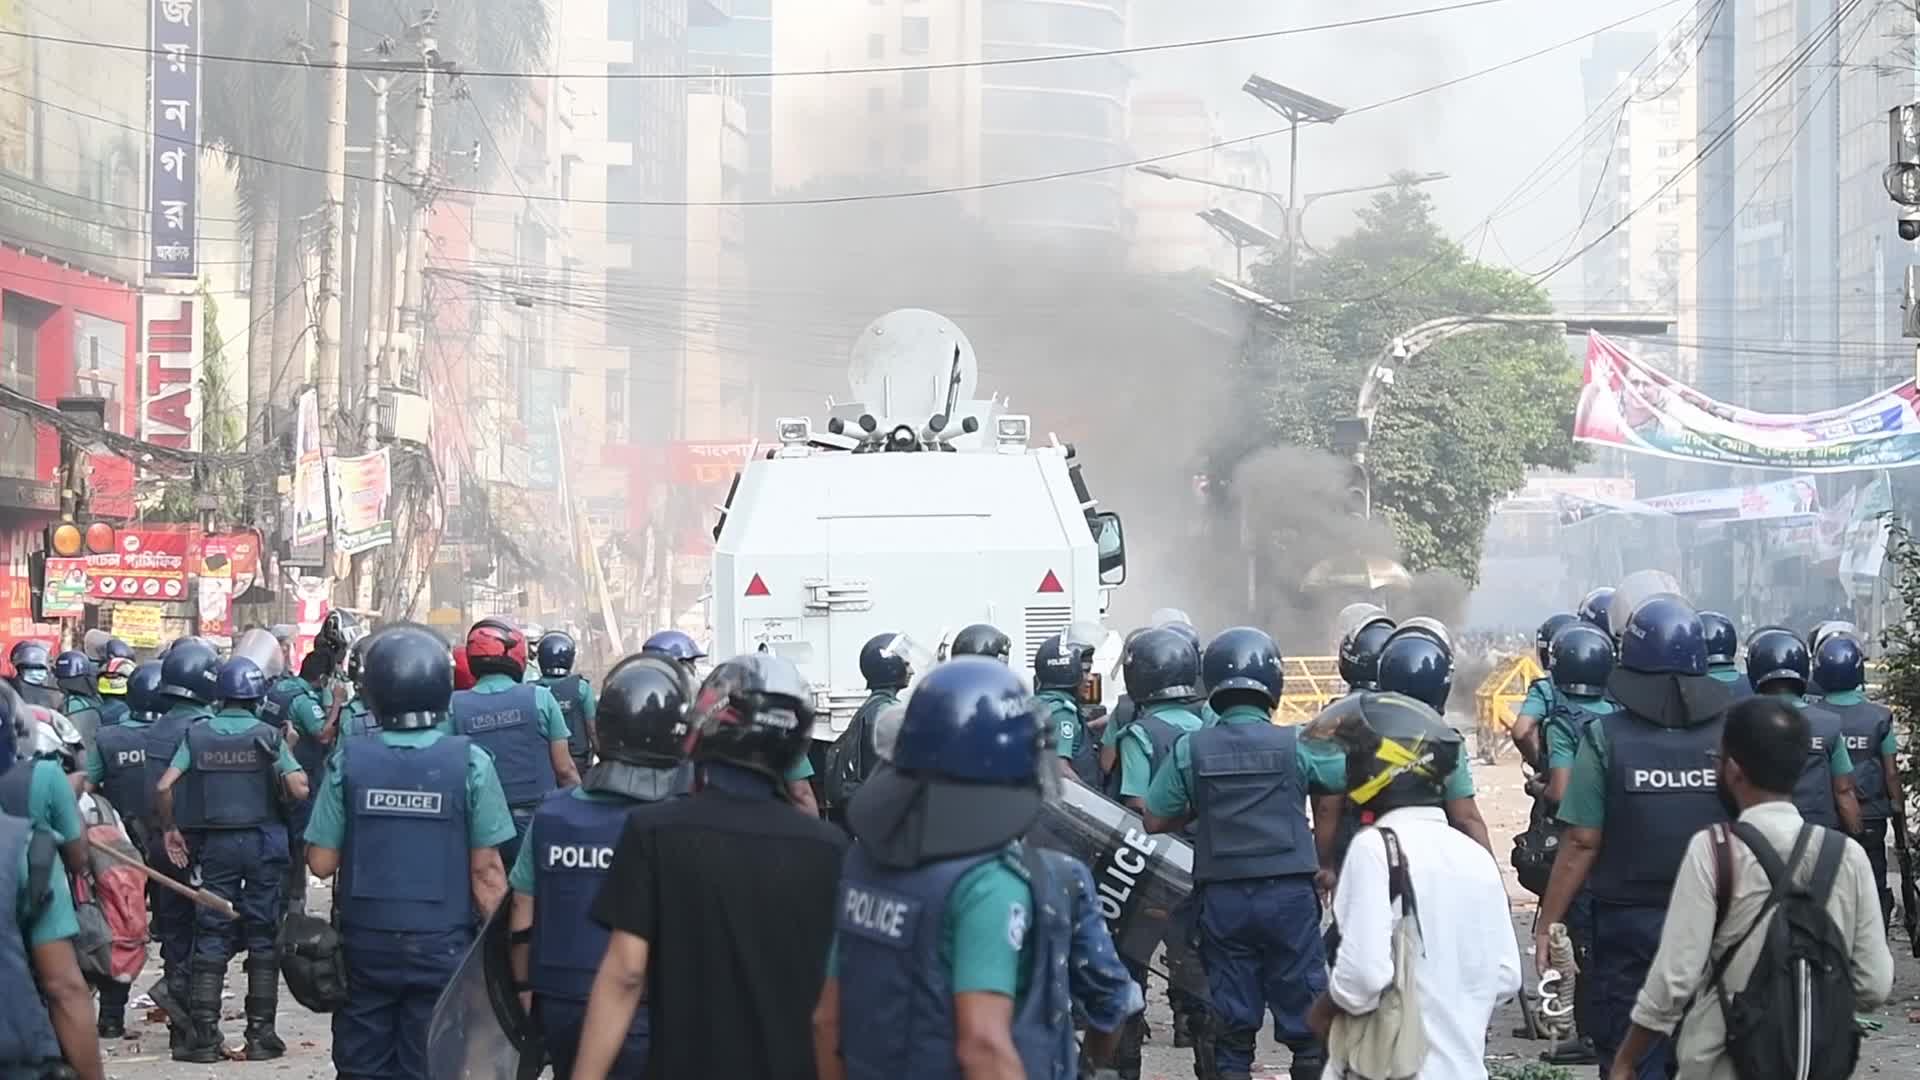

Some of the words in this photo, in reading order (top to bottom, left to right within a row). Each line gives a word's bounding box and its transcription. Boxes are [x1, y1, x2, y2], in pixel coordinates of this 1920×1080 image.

[204, 750, 257, 764] POLICE
[1634, 769, 1717, 788] POLICE
[374, 794, 432, 809] POLICE
[549, 845, 614, 869] POLIC
[1100, 827, 1157, 920] OLICE
[846, 888, 908, 937] POLICE
